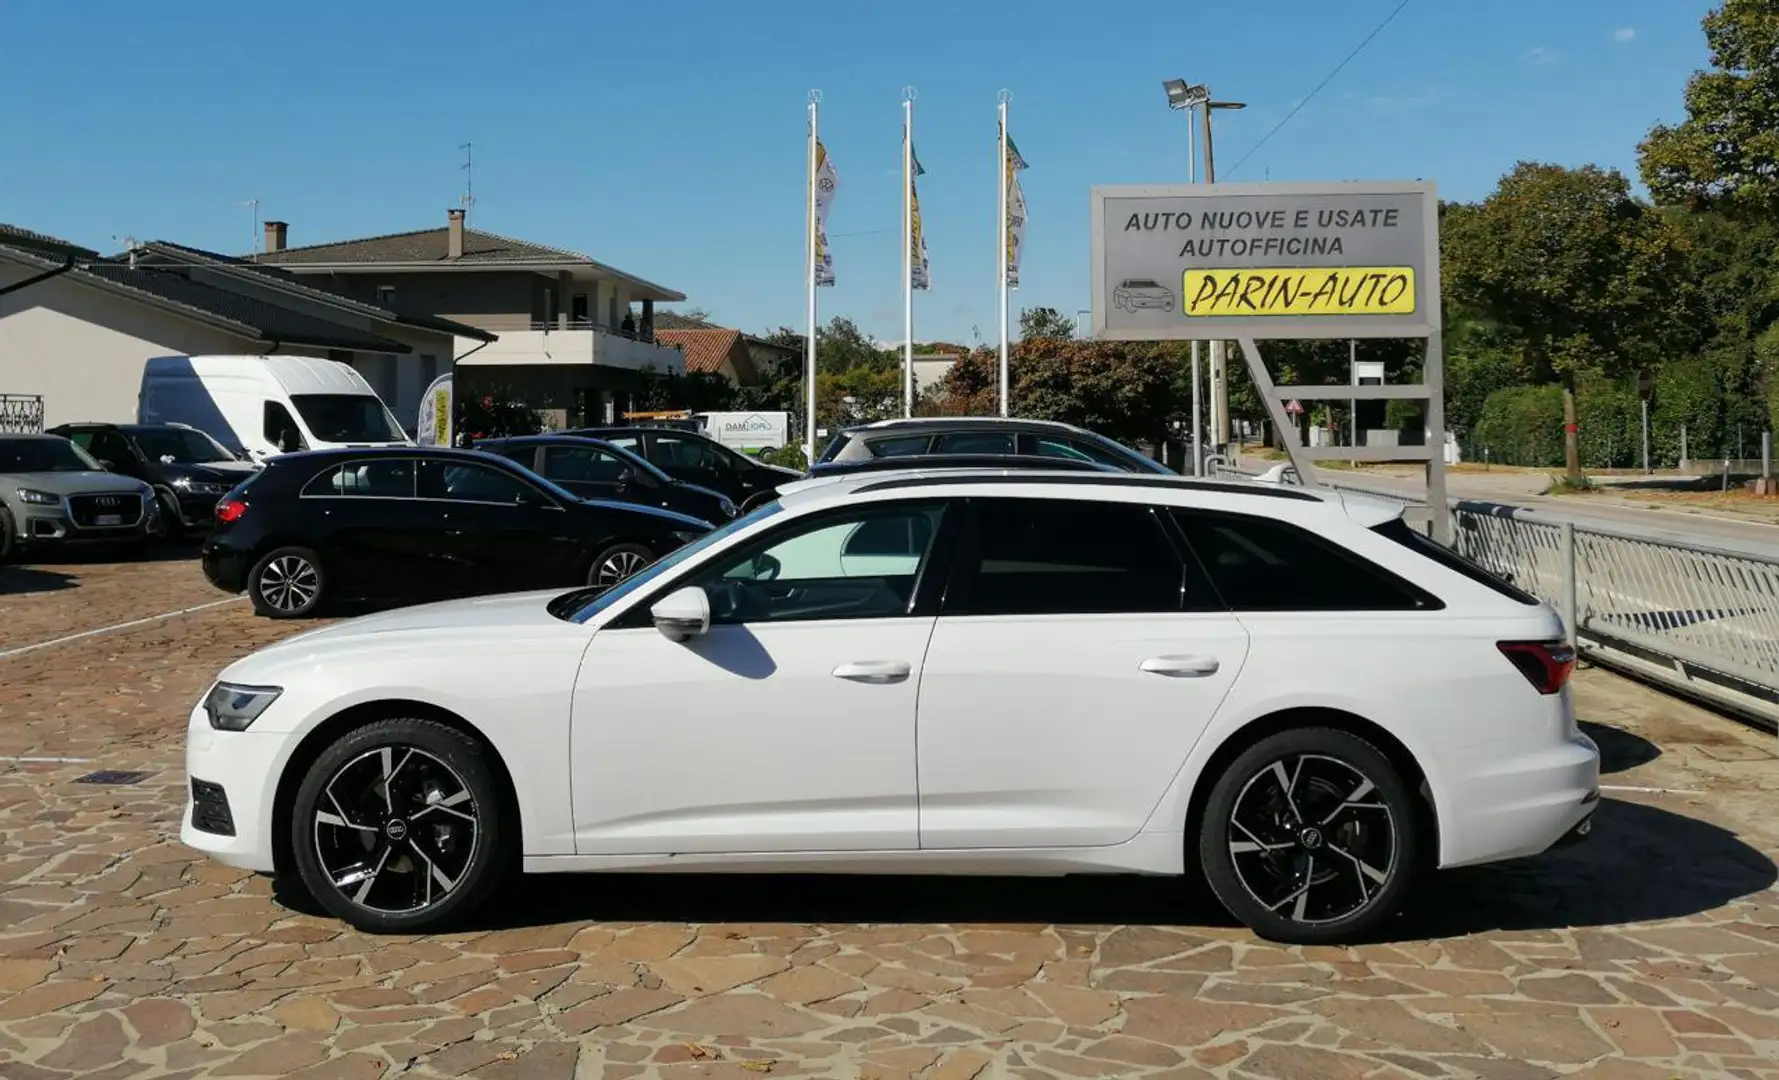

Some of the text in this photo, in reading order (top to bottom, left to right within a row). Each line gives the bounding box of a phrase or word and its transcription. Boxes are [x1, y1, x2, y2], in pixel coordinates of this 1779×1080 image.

[1125, 209, 1399, 231] AUTO NUOVE E USATE
[1179, 237, 1344, 257] AUTOFFICINA
[1190, 271, 1408, 312] PARIN-AUTO
